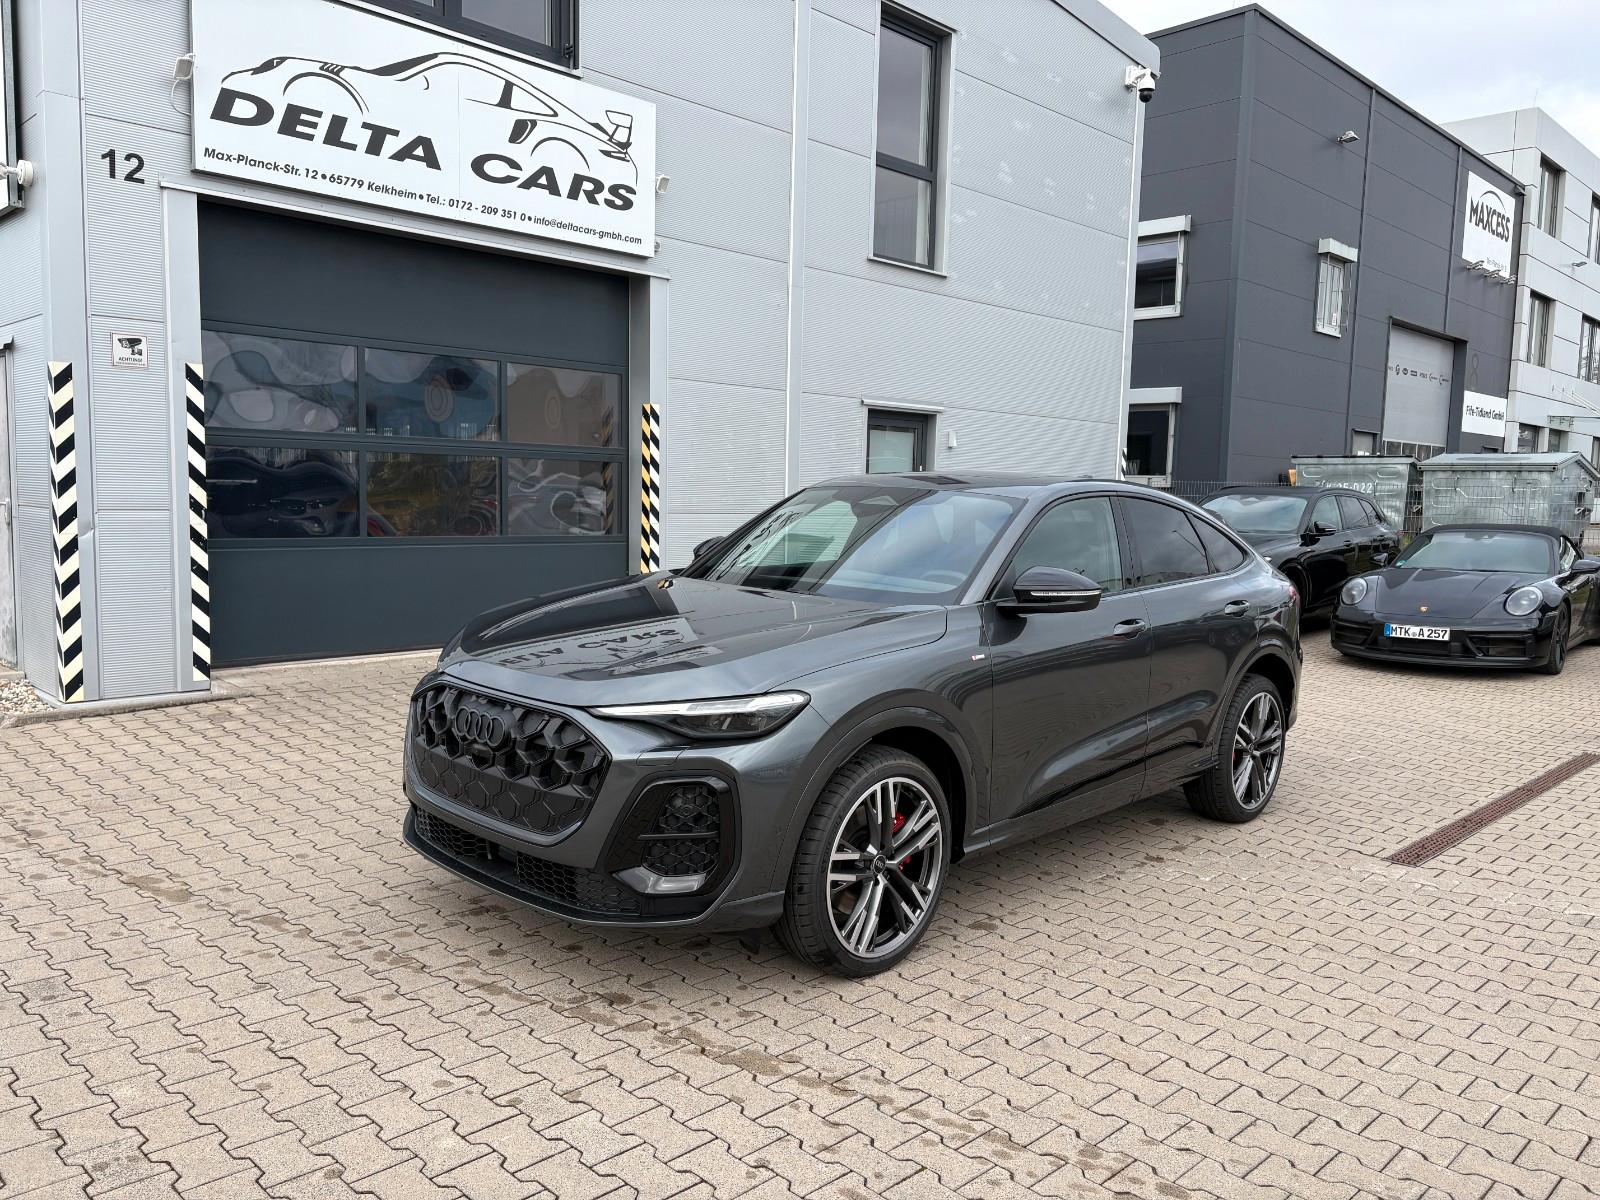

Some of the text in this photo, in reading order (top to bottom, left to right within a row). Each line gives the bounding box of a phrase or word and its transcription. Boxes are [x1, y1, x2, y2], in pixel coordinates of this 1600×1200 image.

[100, 148, 145, 184] 12
[210, 87, 637, 211] DELTA CARS
[203, 147, 302, 177] Max-Planck-Str.
[305, 168, 319, 180] 12
[328, 173, 365, 189] 65779
[367, 181, 417, 200] Kelkheim
[426, 193, 446, 206] Tel.:
[448, 198, 473, 211] 0172
[480, 204, 499, 216] 209
[500, 208, 517, 220] 351
[519, 212, 526, 222] 0
[533, 215, 642, 245] info@deltacars-gmbh.com
[1469, 196, 1510, 242] MAXCESS
[1391, 626, 1448, 639] MTK A 257
